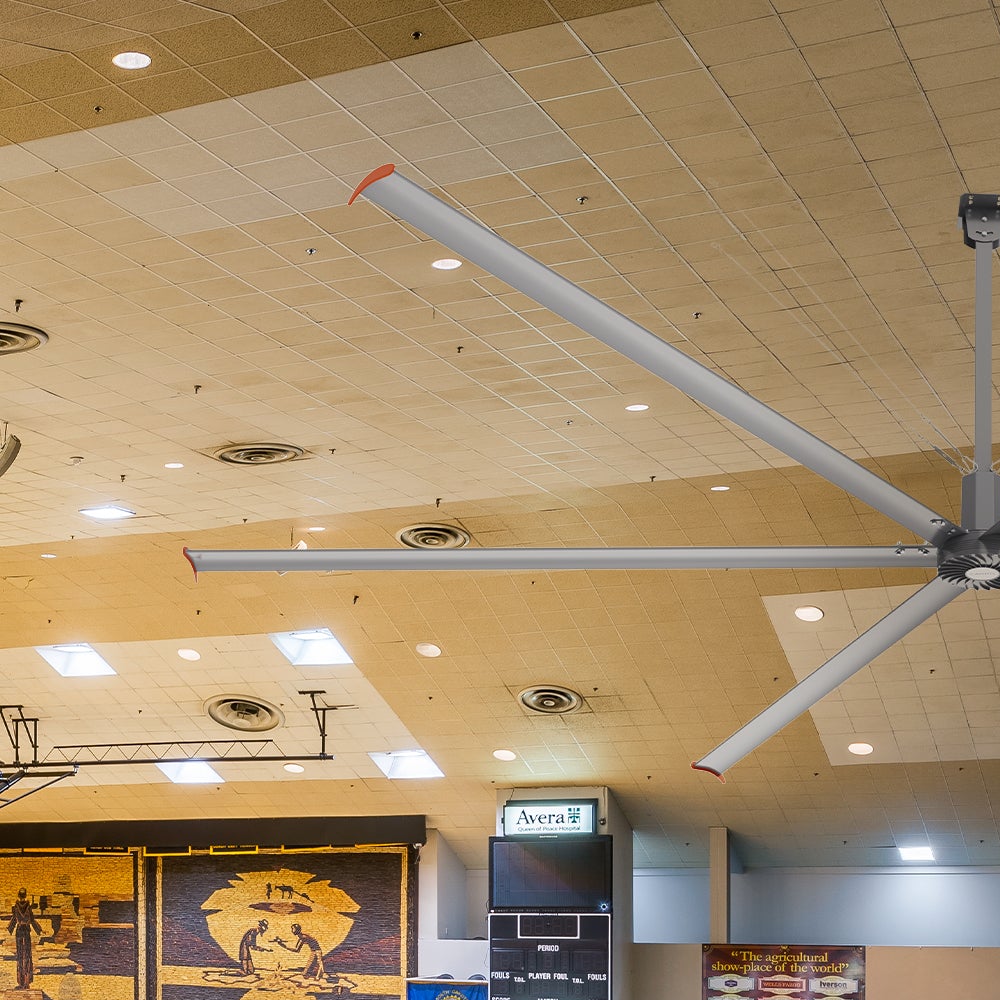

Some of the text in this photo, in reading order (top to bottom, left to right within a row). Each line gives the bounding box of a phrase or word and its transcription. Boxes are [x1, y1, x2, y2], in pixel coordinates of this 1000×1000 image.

[516, 809, 565, 825] Avera
[537, 944, 559, 952] PERIOD
[765, 952, 828, 965] agricultural
[711, 961, 773, 974] show-place
[774, 963, 787, 972] of
[790, 963, 808, 973] the
[490, 971, 510, 979] FOULS
[528, 972, 569, 980] PLAYER FOUL
[587, 973, 607, 981] FOULS
[820, 981, 847, 989] Iverson
